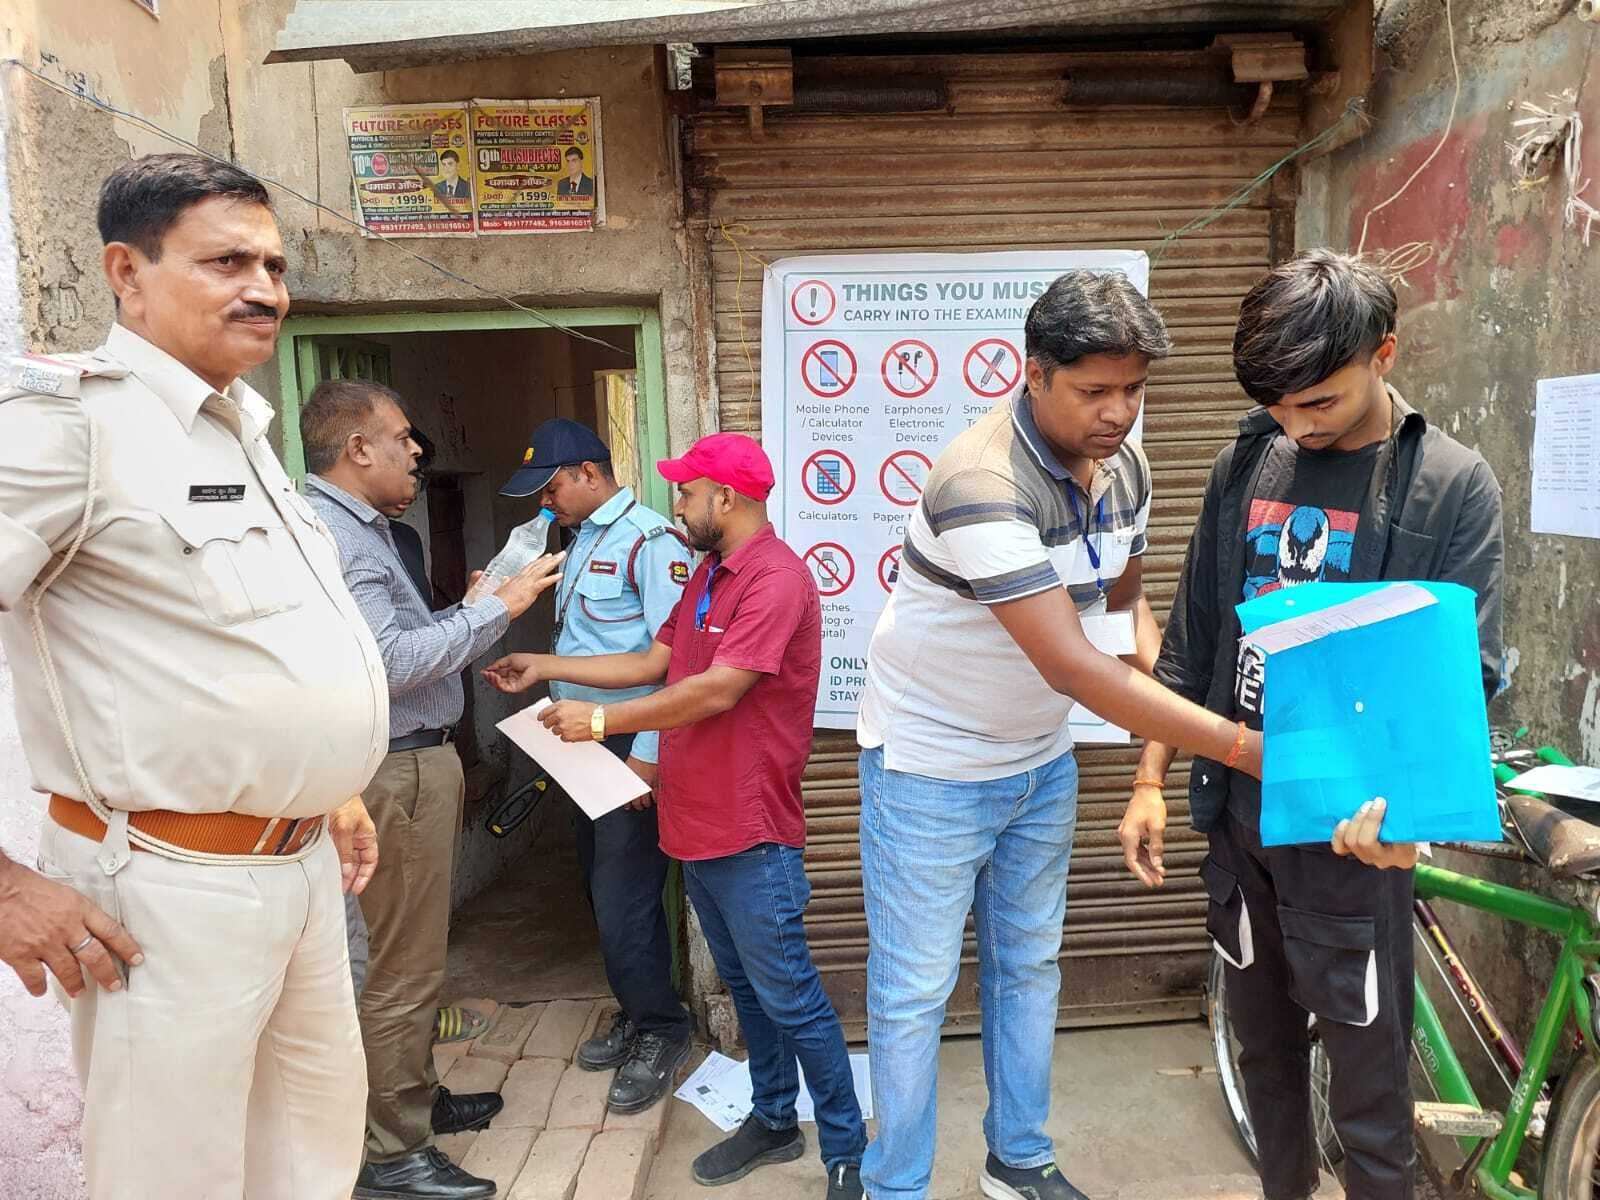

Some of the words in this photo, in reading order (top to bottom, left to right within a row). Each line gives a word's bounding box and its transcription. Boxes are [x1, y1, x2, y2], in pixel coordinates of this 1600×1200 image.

[352, 119, 404, 133] FUTURE
[408, 117, 463, 131] CLASSES
[478, 115, 530, 128] FUTURE
[534, 114, 588, 128] CLASSES
[480, 148, 499, 170] 9th
[517, 148, 560, 163] SUBJECTS
[842, 282, 928, 301] THINGS
[936, 282, 984, 300] YOU
[993, 281, 1052, 300] MUS
[843, 309, 890, 321] CARRY
[895, 308, 930, 321] INTO
[932, 308, 961, 320] THE
[796, 404, 831, 414] Mobile
[834, 404, 870, 414] Phone
[884, 404, 944, 417] Earphones
[808, 417, 863, 428] Calculator
[889, 418, 945, 429] Electronic
[812, 432, 853, 442] Devices
[895, 432, 938, 443] Devices
[798, 510, 858, 521] Calculators
[873, 512, 905, 523] Paper
[830, 656, 868, 670] ONLY
[830, 675, 842, 686] ID
[830, 690, 859, 702] STAY
